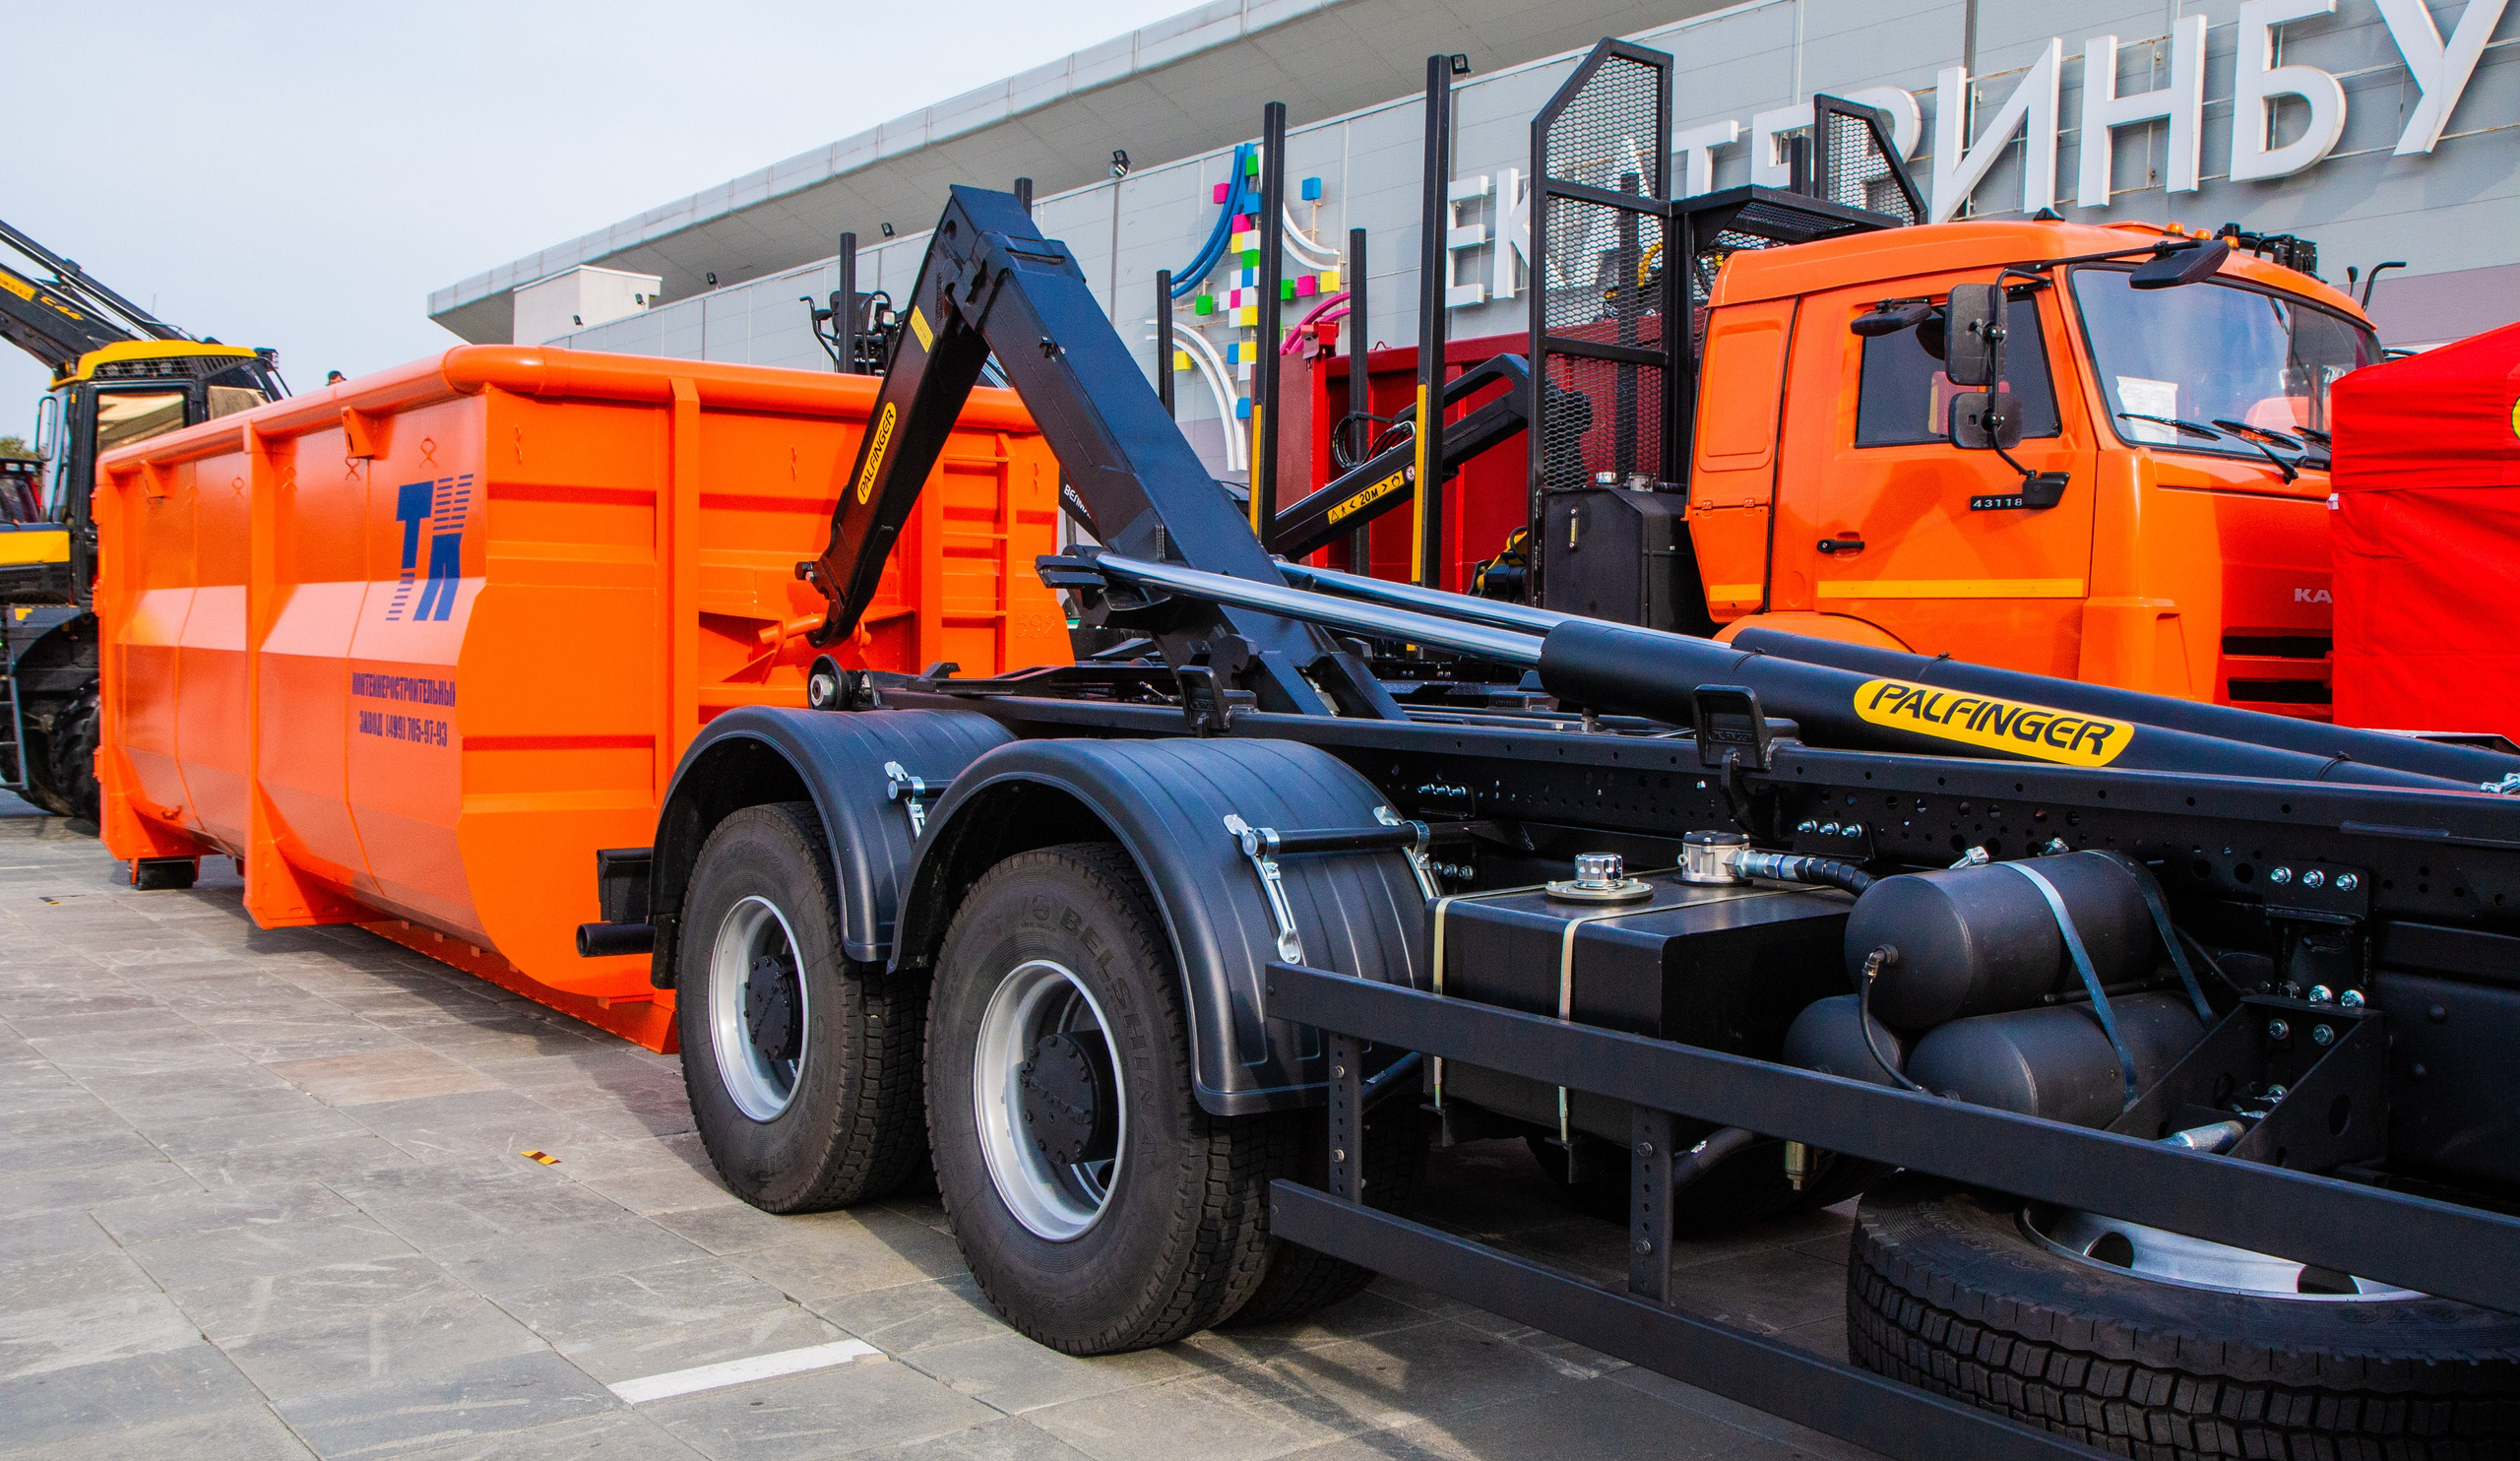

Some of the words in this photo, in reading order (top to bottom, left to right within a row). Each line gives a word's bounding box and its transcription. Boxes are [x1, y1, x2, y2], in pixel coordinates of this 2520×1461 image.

[859, 409, 894, 498] PALFINGER
[1973, 498, 2023, 508] 43118
[359, 710, 383, 737] ЗАВОД
[386, 714, 406, 740] (499)
[408, 717, 447, 747] 705-97-93
[1868, 682, 2115, 756] PALFINGER
[1060, 905, 1159, 1155] BELSHINA
